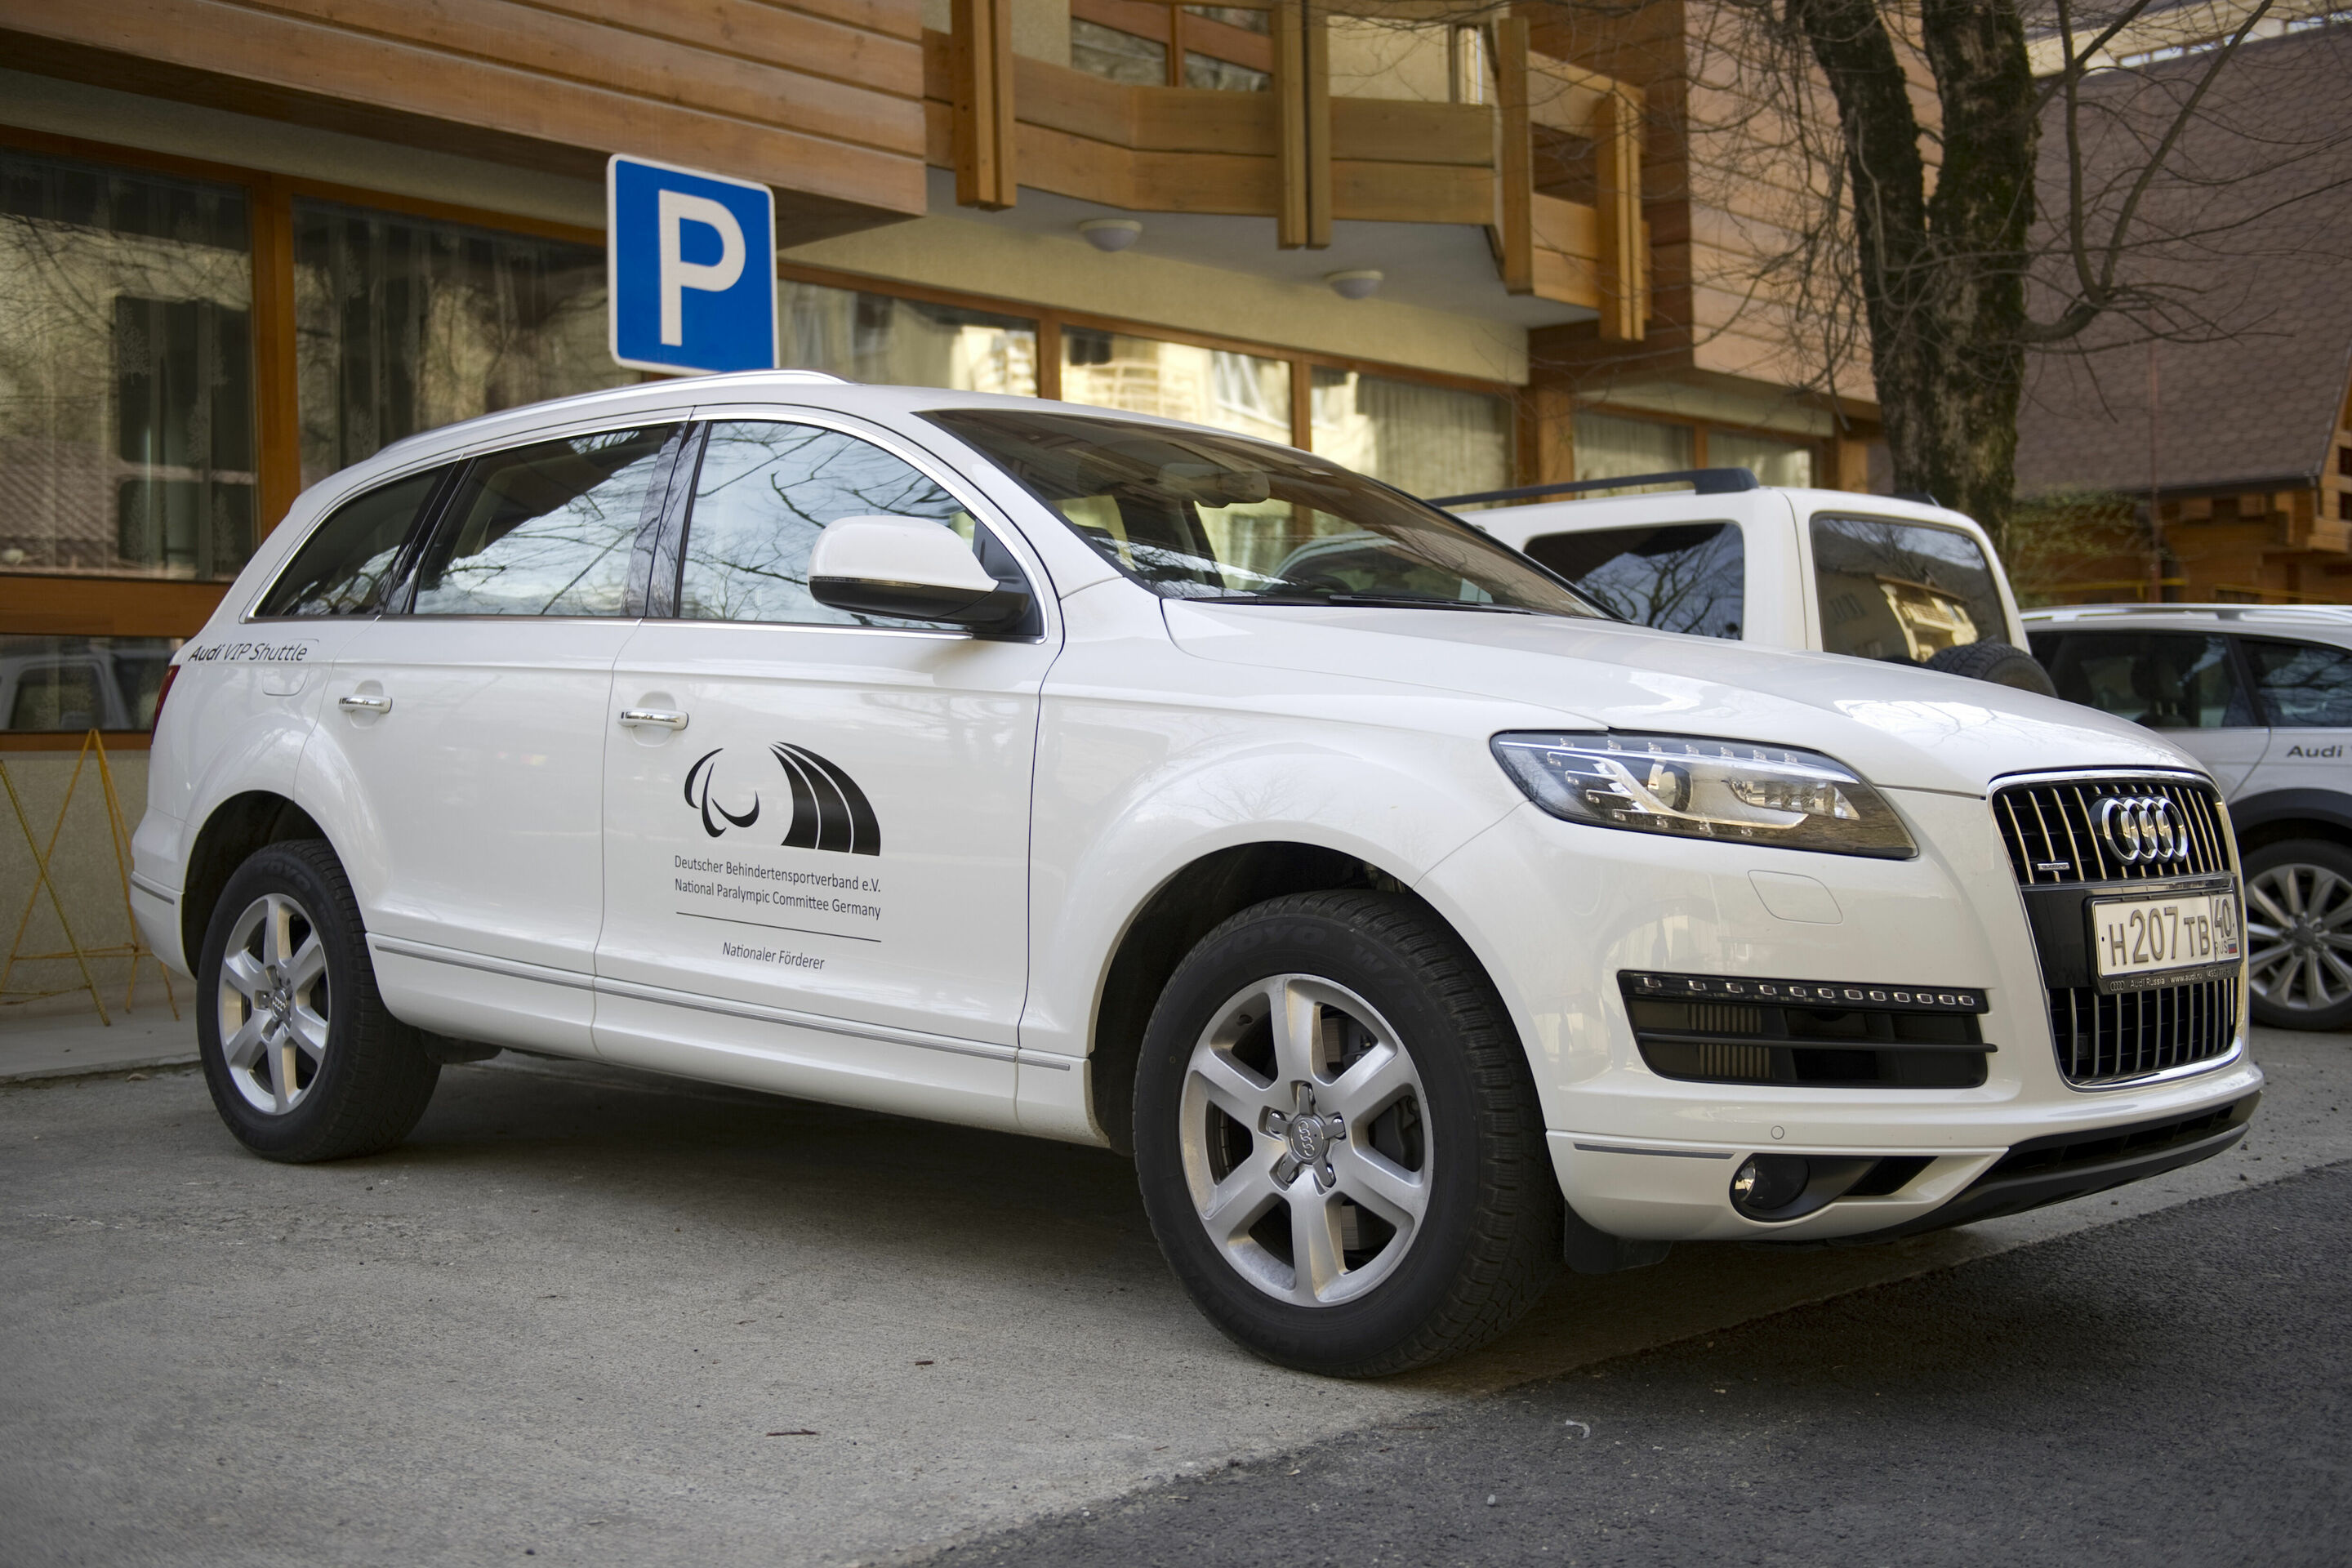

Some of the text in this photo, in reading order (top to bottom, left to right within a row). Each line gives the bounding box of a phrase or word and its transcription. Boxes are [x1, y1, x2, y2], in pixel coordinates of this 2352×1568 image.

[658, 189, 746, 346] P
[189, 643, 308, 662] Audi VIP Shuttle
[2287, 745, 2343, 758] Audi
[675, 855, 881, 893] Deutscher Behindertensportverband e.V.
[675, 878, 881, 920] National Paralympic Committee Germany
[2215, 898, 2232, 938] 40
[723, 942, 825, 970] Nationaler Förderer
[2215, 940, 2228, 955] RUS
[2130, 976, 2145, 989] Audi
[2146, 976, 2165, 987] Russia
